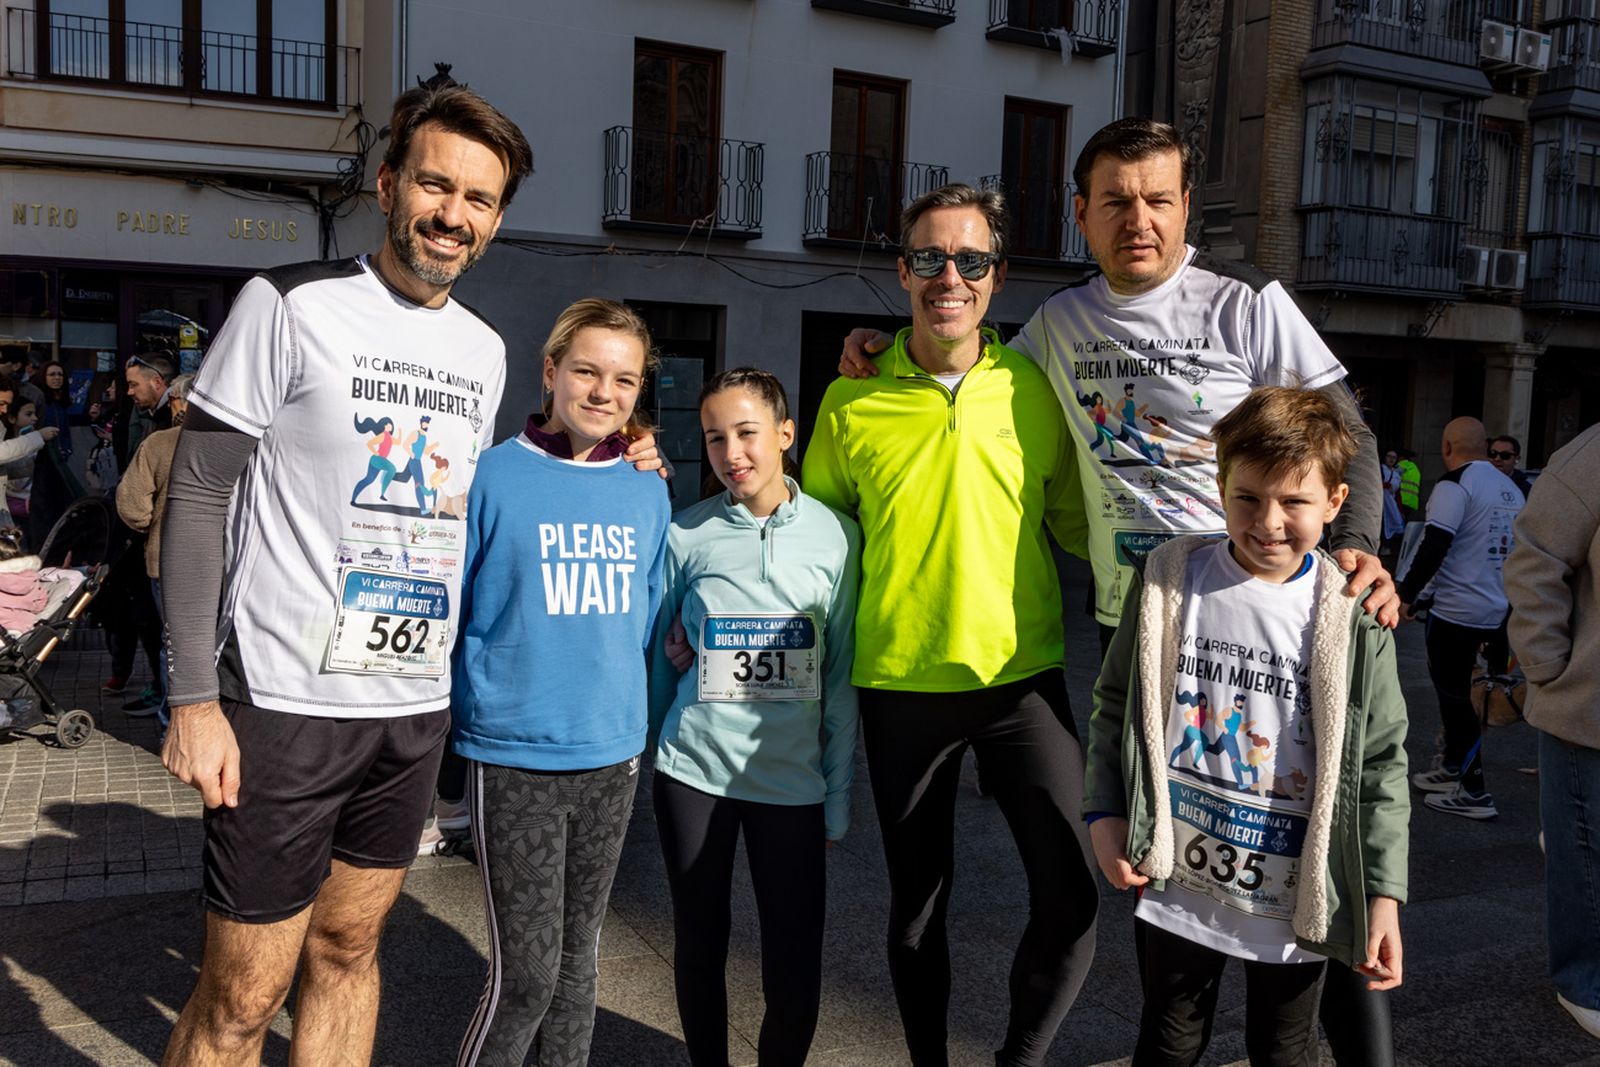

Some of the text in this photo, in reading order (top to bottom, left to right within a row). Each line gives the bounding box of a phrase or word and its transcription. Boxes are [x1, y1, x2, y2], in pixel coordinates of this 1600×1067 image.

[12, 203, 298, 242] NTRO PADRE JESUS
[1073, 337, 1211, 353] VI CARRERA CAMINATA
[352, 354, 484, 396] VI CARRERA CAMINATA
[1074, 357, 1178, 380] BUENA MUERTE
[351, 376, 468, 418] BUENA MUERTE
[538, 523, 637, 560] PLEASE
[357, 591, 432, 614] BUENA MUERTE
[361, 577, 445, 597] VI CARRERA CAMINATA
[541, 562, 636, 615] WAIT
[365, 615, 430, 654] 562
[715, 621, 804, 630] VI CARRERA CAMINATA
[715, 633, 786, 646] BUENA MUERTE
[733, 651, 786, 683] 351
[1194, 636, 1255, 661] CARRERA
[1177, 653, 1294, 700] BUENA MUERTE
[1178, 801, 1265, 847] BUENA MUERTE
[1180, 787, 1293, 830] VI CARRERA CAMINATA
[1184, 833, 1267, 892] 635
